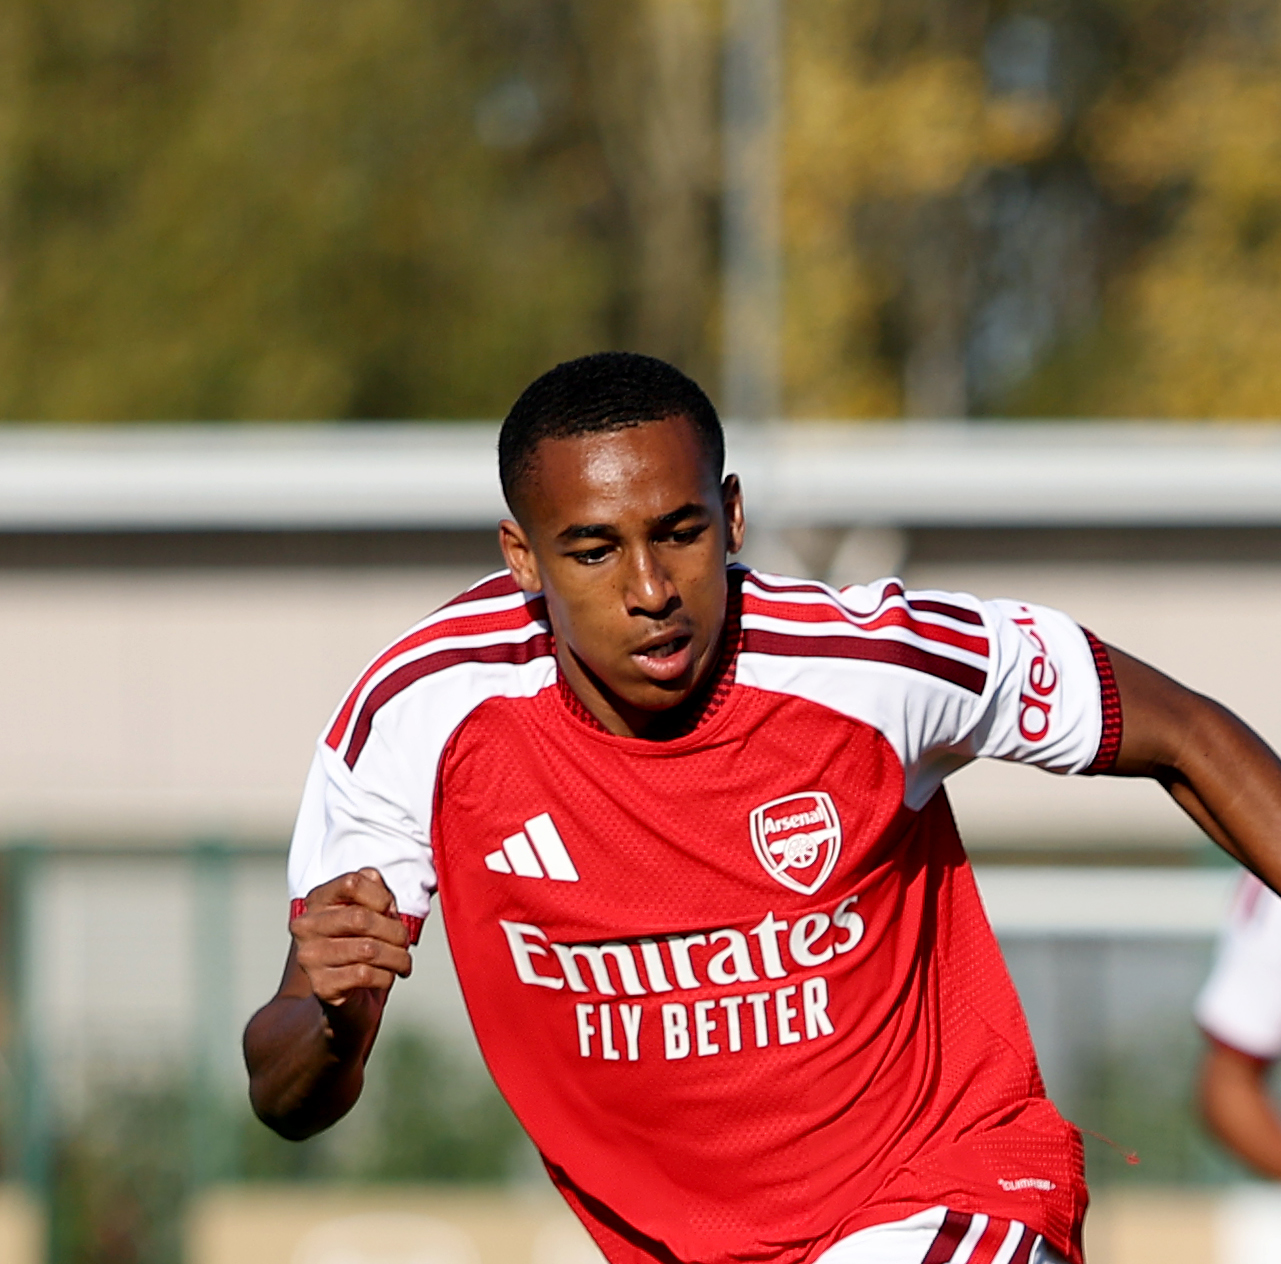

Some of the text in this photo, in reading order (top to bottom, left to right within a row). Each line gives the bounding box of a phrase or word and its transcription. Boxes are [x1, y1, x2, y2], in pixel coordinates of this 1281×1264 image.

[764, 806, 825, 835] Arsenal
[499, 895, 864, 996] Emirates
[575, 977, 834, 1061] FLY BETTER
